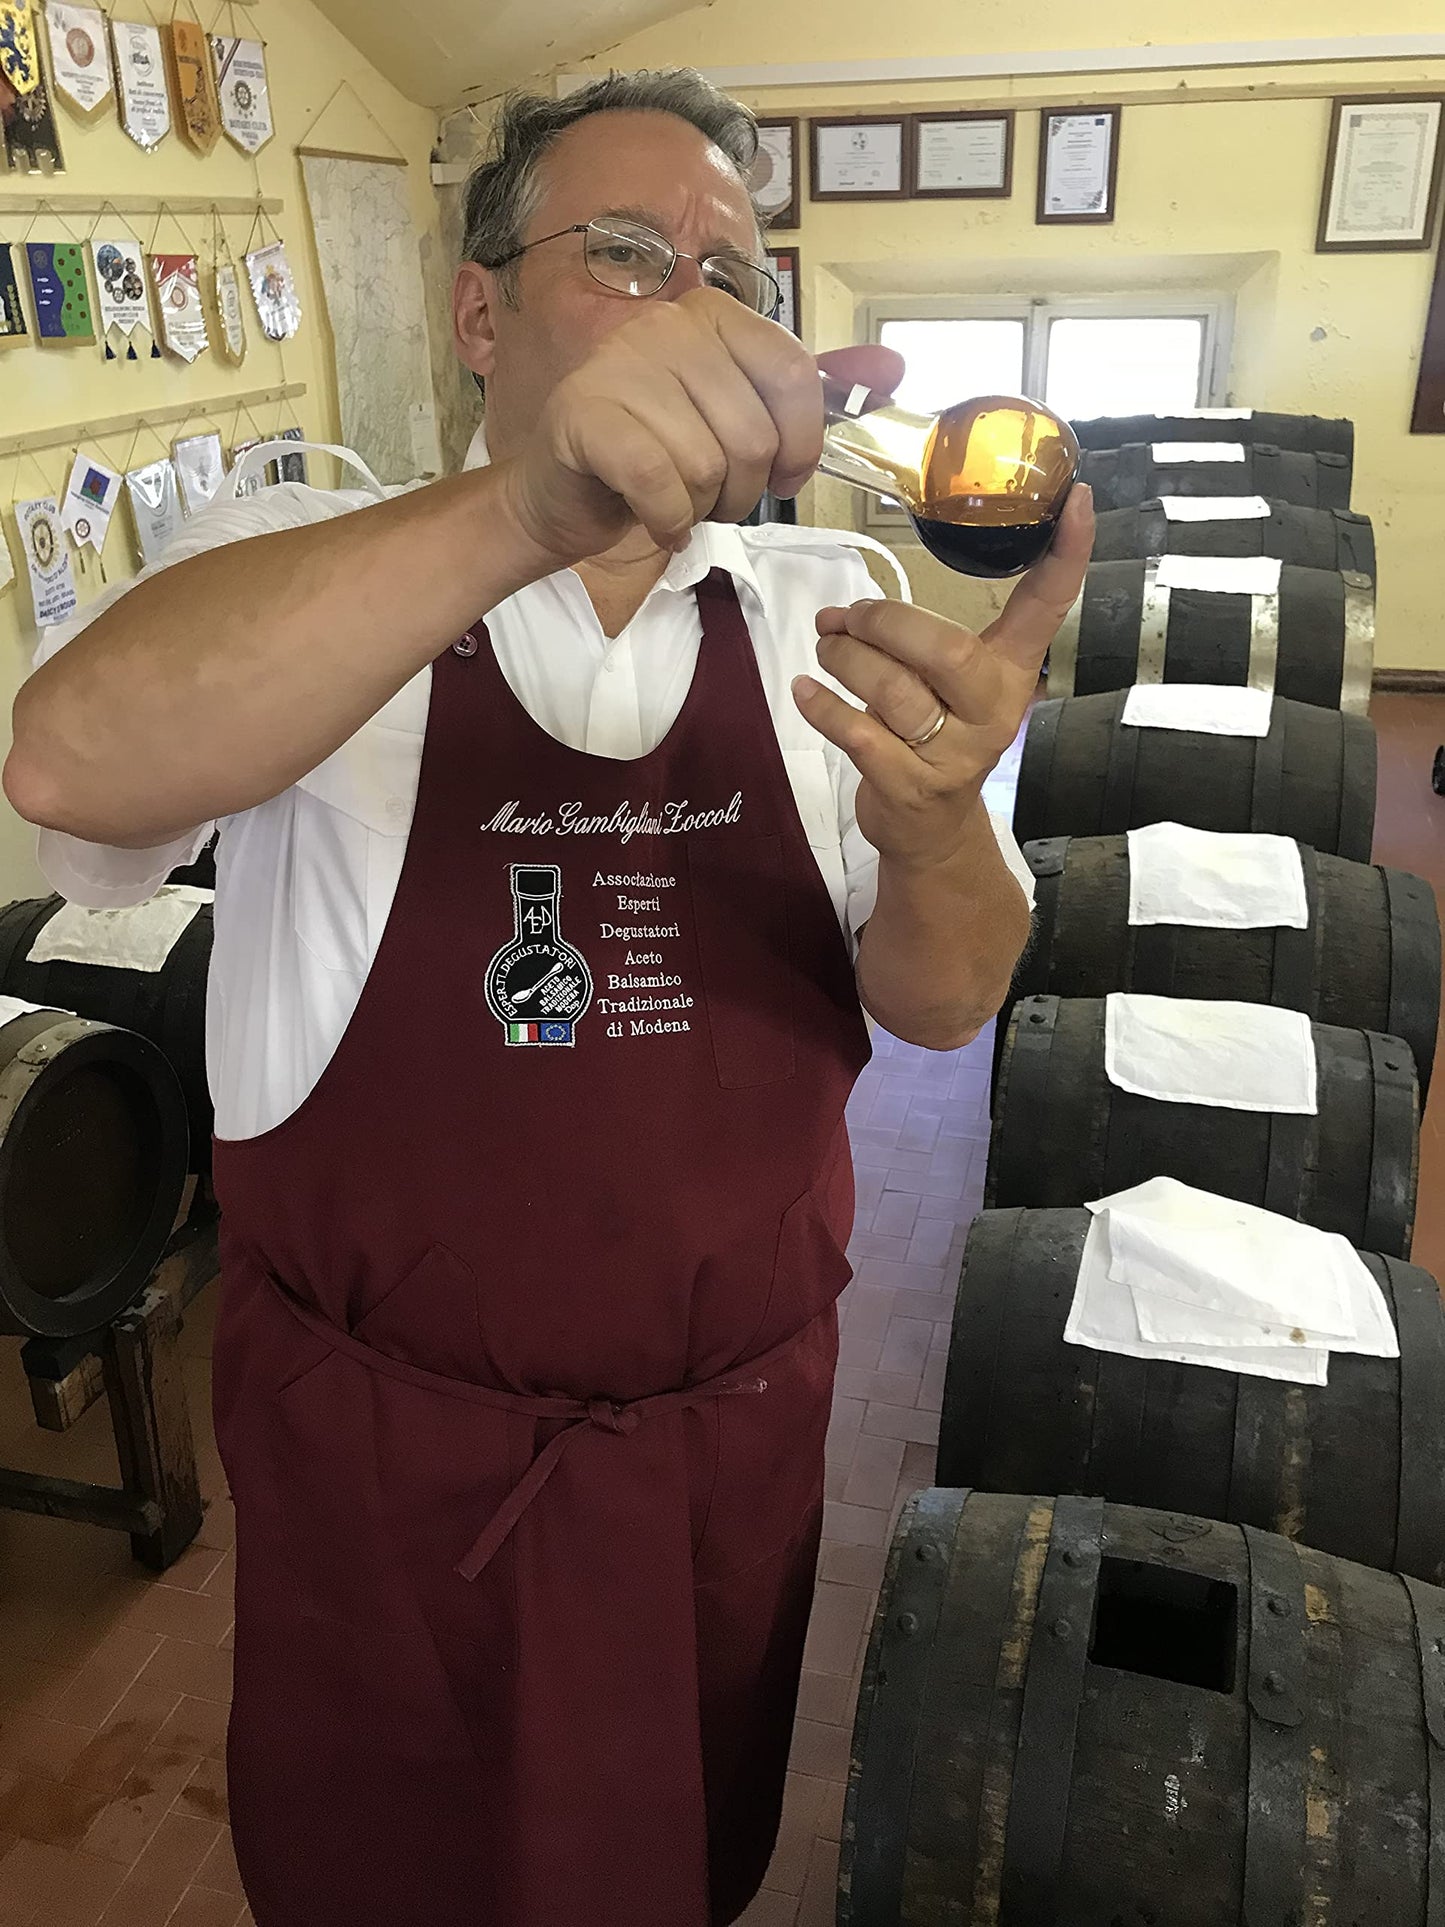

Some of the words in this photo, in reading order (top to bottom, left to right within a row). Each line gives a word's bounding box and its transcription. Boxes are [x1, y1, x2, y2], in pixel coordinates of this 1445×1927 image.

[480, 800, 554, 835] Mario
[555, 801, 663, 845] Gambigliani
[663, 791, 742, 835] Zoccoli
[592, 871, 677, 888] Associazione
[617, 895, 661, 914] Esperti
[600, 922, 680, 941] Degustatori
[500, 944, 577, 977] DEGUSTATORI
[625, 950, 663, 965] Aceto
[539, 974, 572, 1006] BALSAMICO
[540, 976, 560, 996] ACETO
[607, 972, 682, 989] Balsamico
[540, 976, 582, 1015] TRADIZIONALE
[555, 990, 580, 1013] MODENA
[597, 993, 694, 1014] Tradizionale
[630, 1018, 690, 1036] Modena
